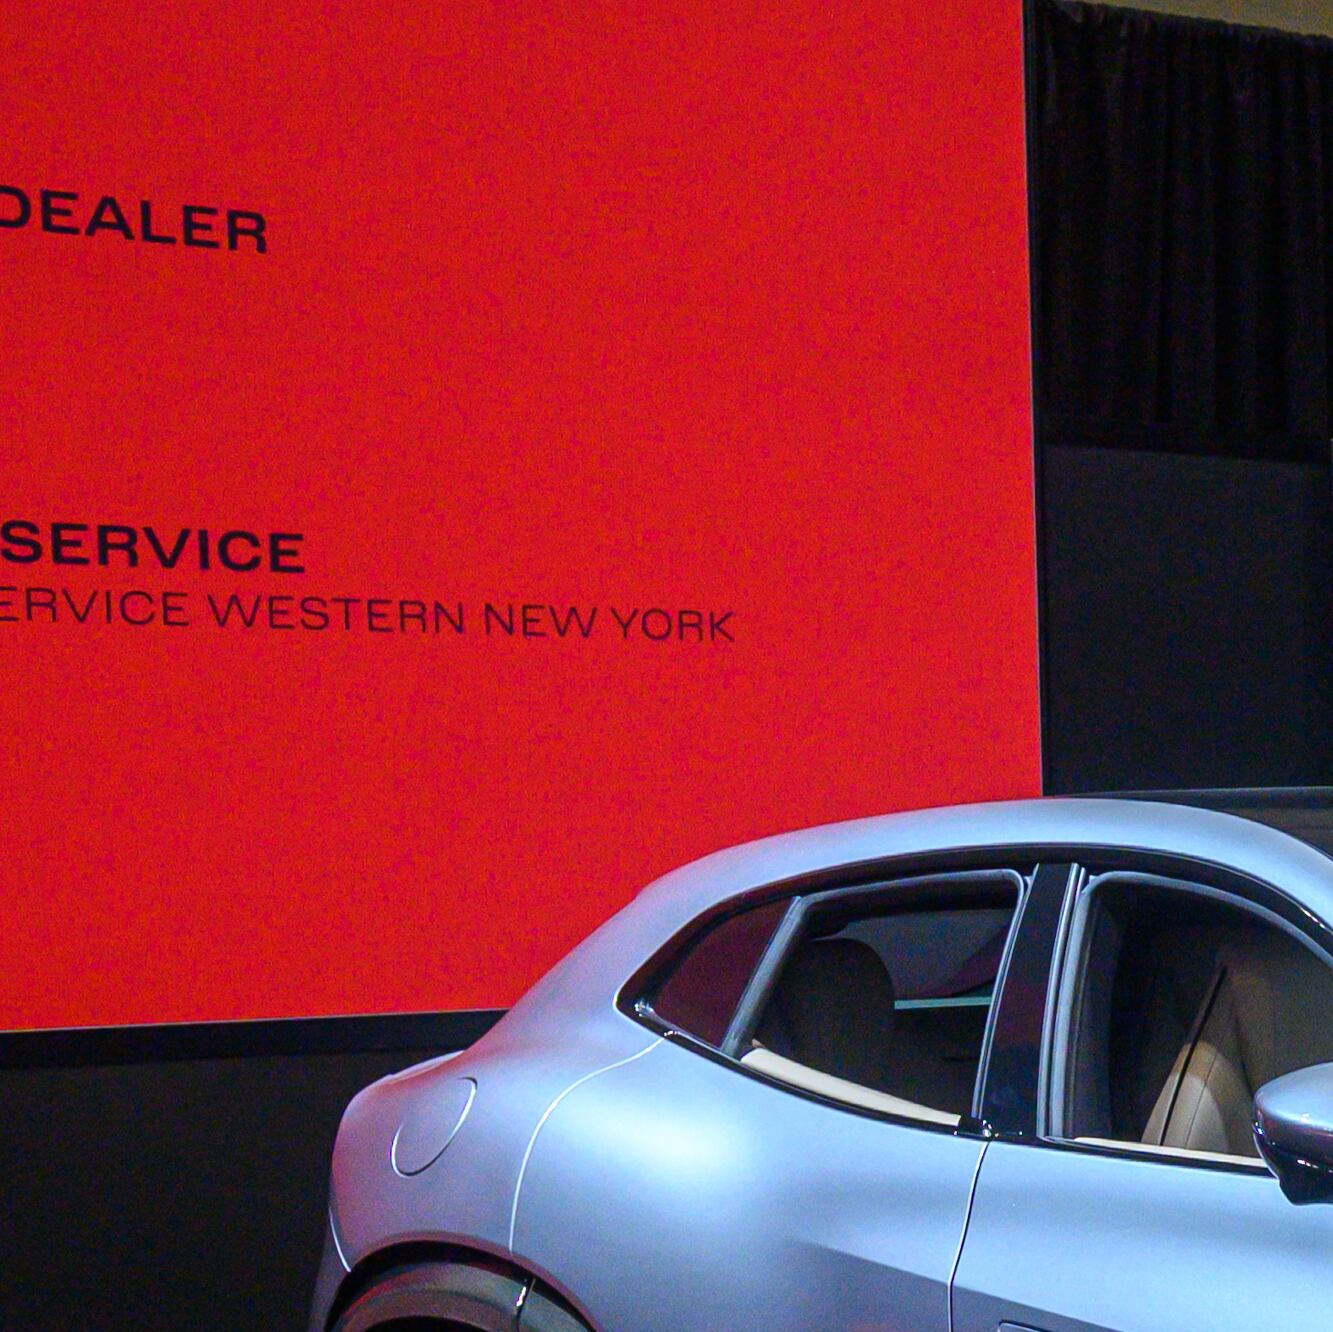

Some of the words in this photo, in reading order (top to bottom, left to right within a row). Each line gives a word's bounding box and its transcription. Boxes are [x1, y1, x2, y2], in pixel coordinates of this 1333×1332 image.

[0, 185, 268, 254] DEALER
[0, 520, 305, 574] SERVICE
[207, 594, 465, 635] WESTERN
[484, 603, 598, 639] NEW
[611, 608, 734, 642] YORK
